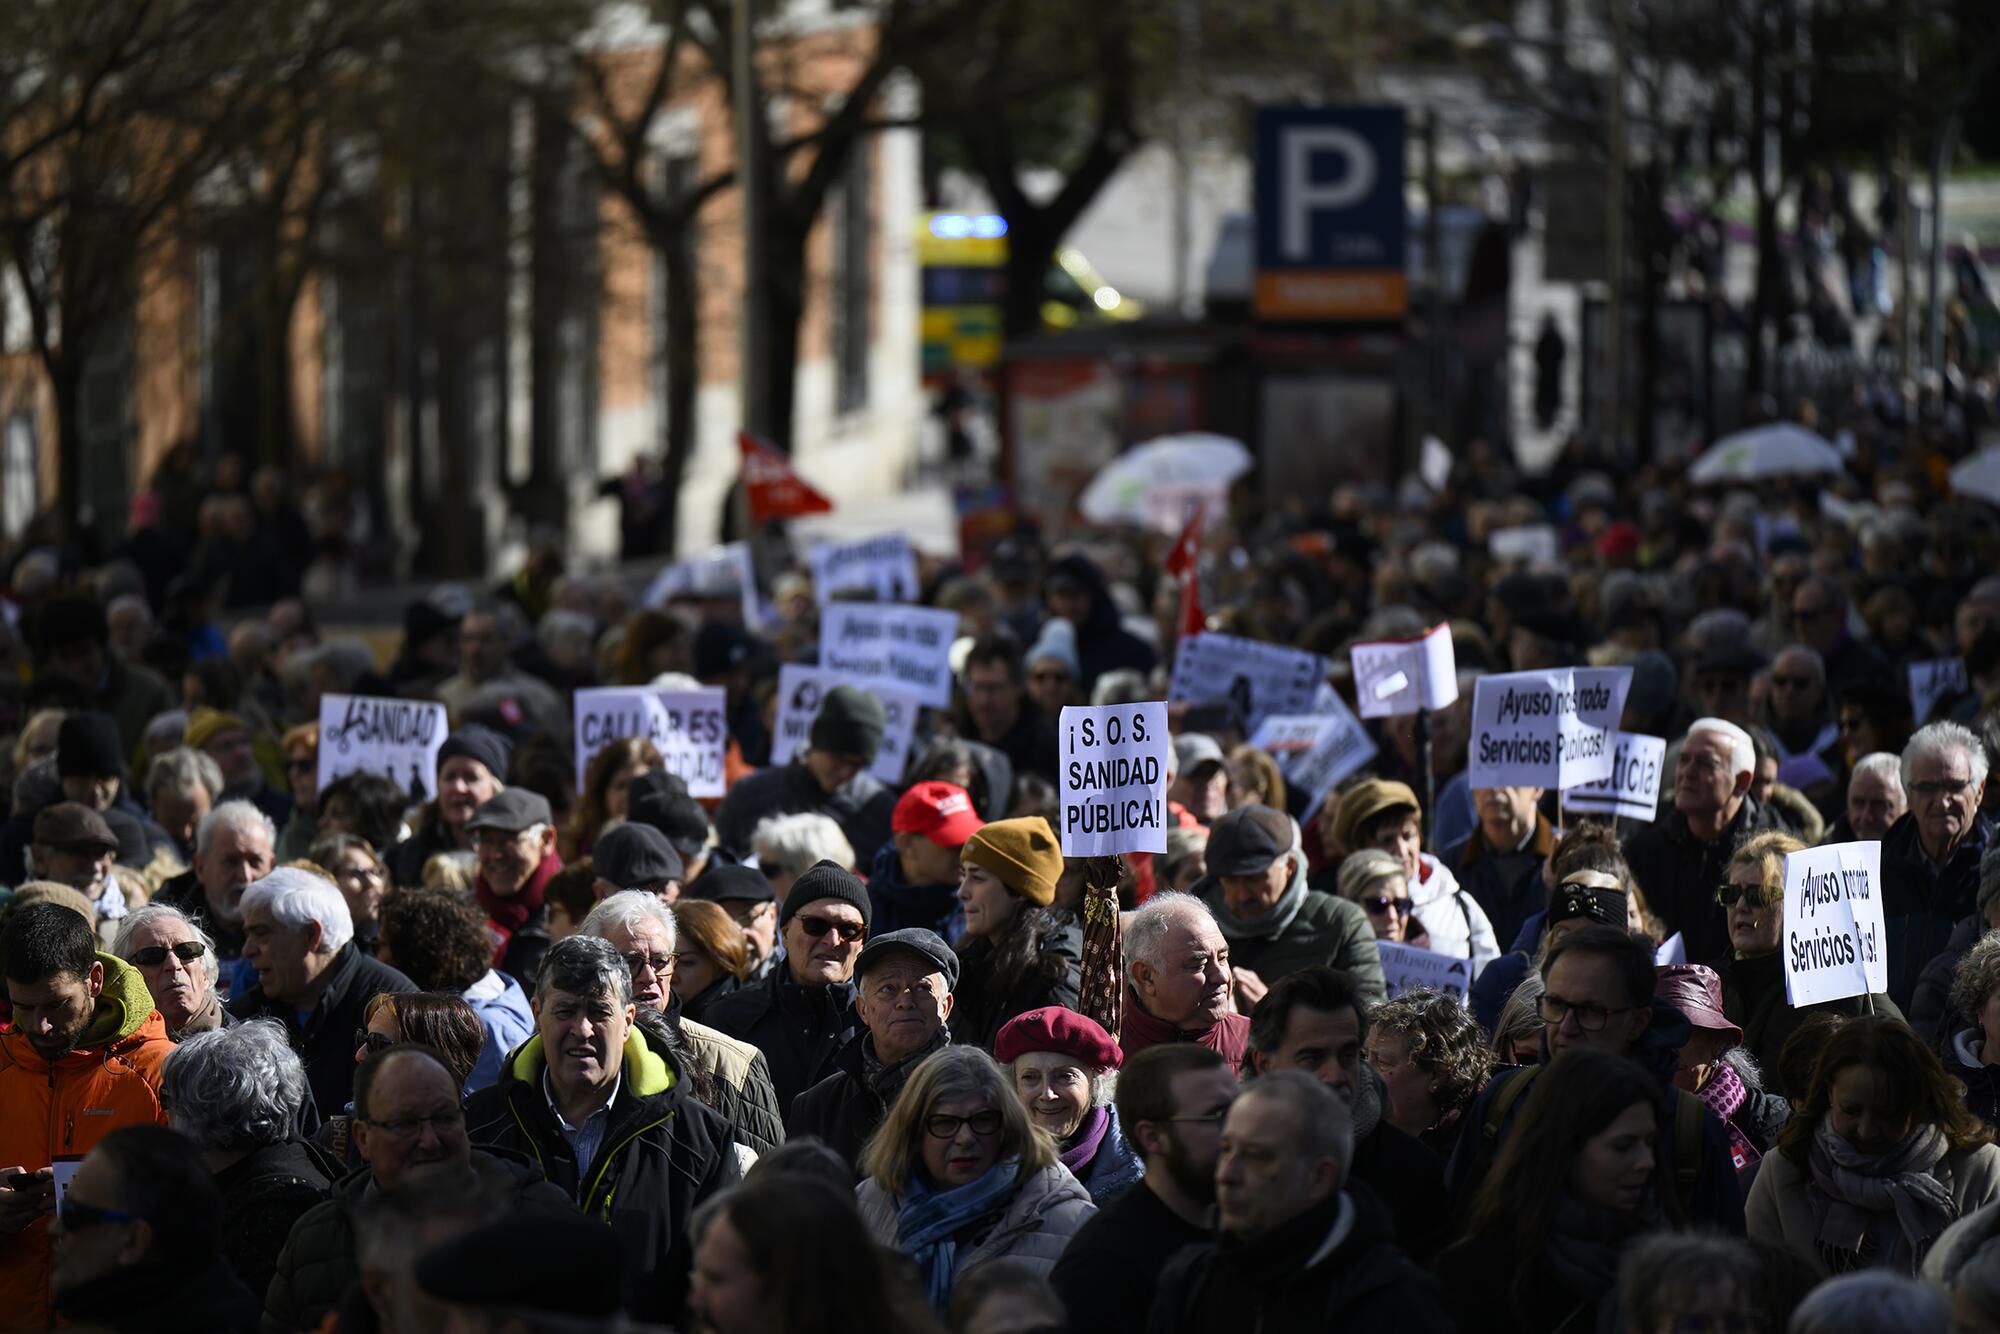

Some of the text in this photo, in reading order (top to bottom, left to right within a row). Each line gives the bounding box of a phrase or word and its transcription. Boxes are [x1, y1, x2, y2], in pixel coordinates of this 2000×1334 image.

[1277, 125, 1379, 260] P
[356, 699, 437, 748] SANIDAD
[1497, 686, 1551, 725] ¡Ayuso
[1579, 681, 1611, 712] roba
[688, 708, 722, 744] ES
[1479, 731, 1551, 764] Servicios
[1068, 756, 1159, 791] SANIDAD
[1568, 742, 1664, 796] ticia!
[1067, 797, 1160, 834] PÚBLICA!
[1800, 866, 1840, 919] ¡Ayuso
[1790, 926, 1855, 973] Servicios
